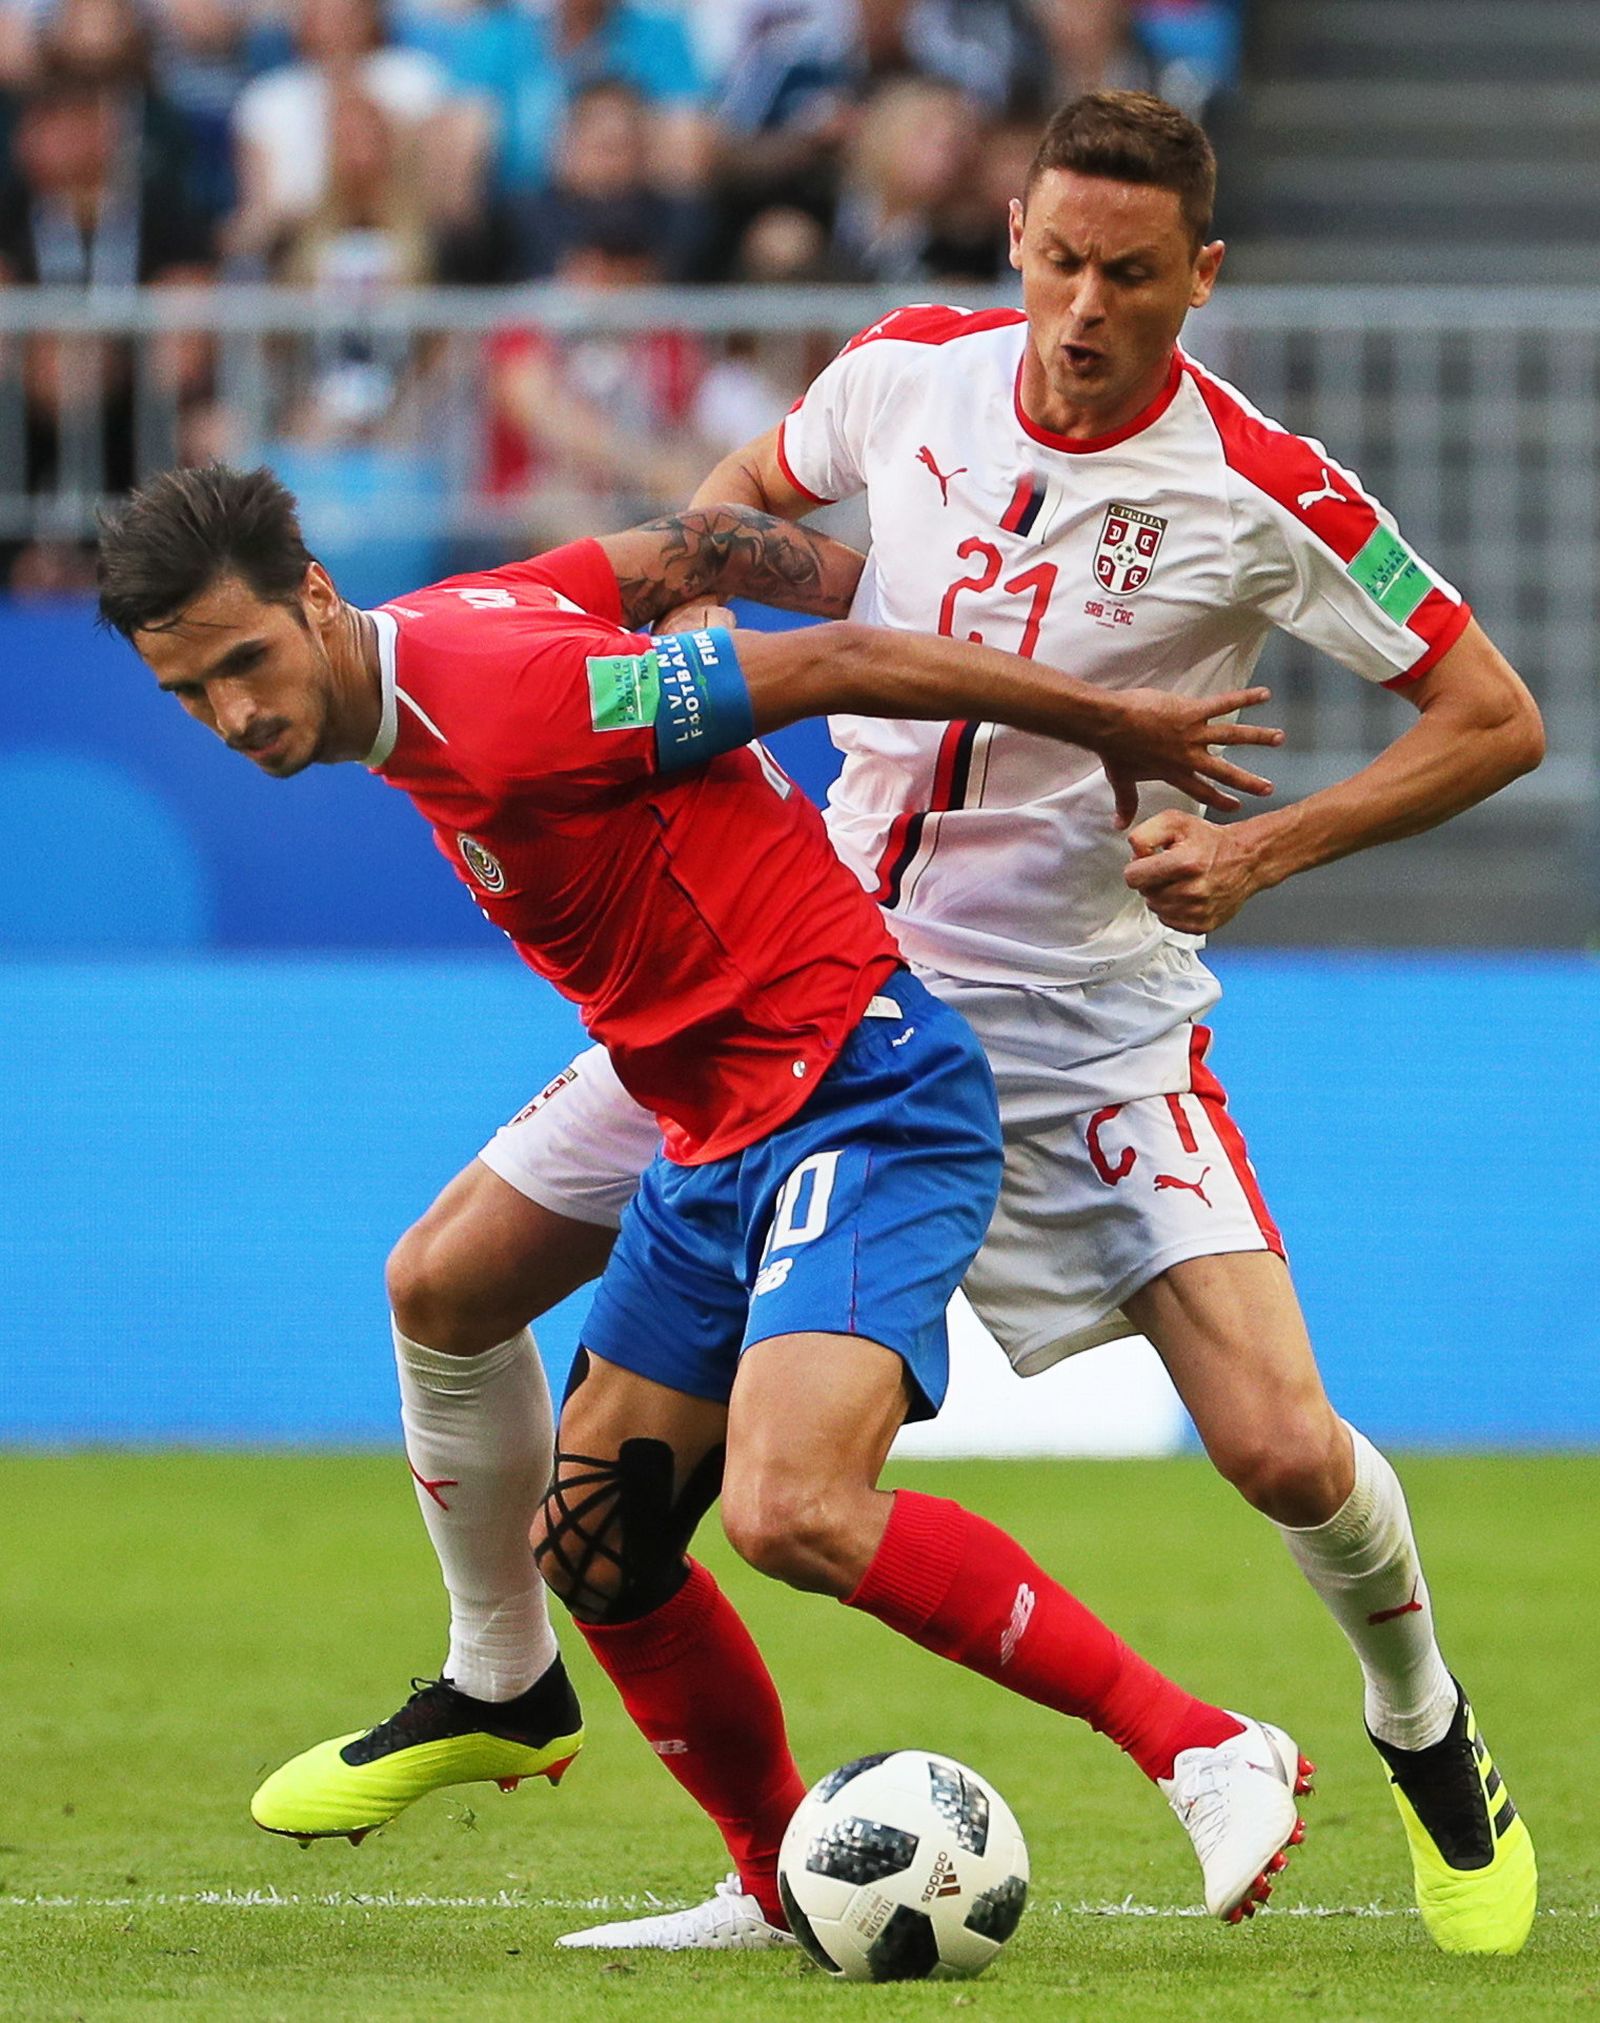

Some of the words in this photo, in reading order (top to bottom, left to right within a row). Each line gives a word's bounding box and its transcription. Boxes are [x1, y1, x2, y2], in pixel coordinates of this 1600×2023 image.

[1366, 542, 1401, 588] LIVIN
[1370, 550, 1406, 595] FOOTBAL
[938, 536, 1059, 660] 21
[693, 630, 719, 666] FIFA
[760, 1150, 844, 1268] 0
[921, 1851, 948, 1903] adidas
